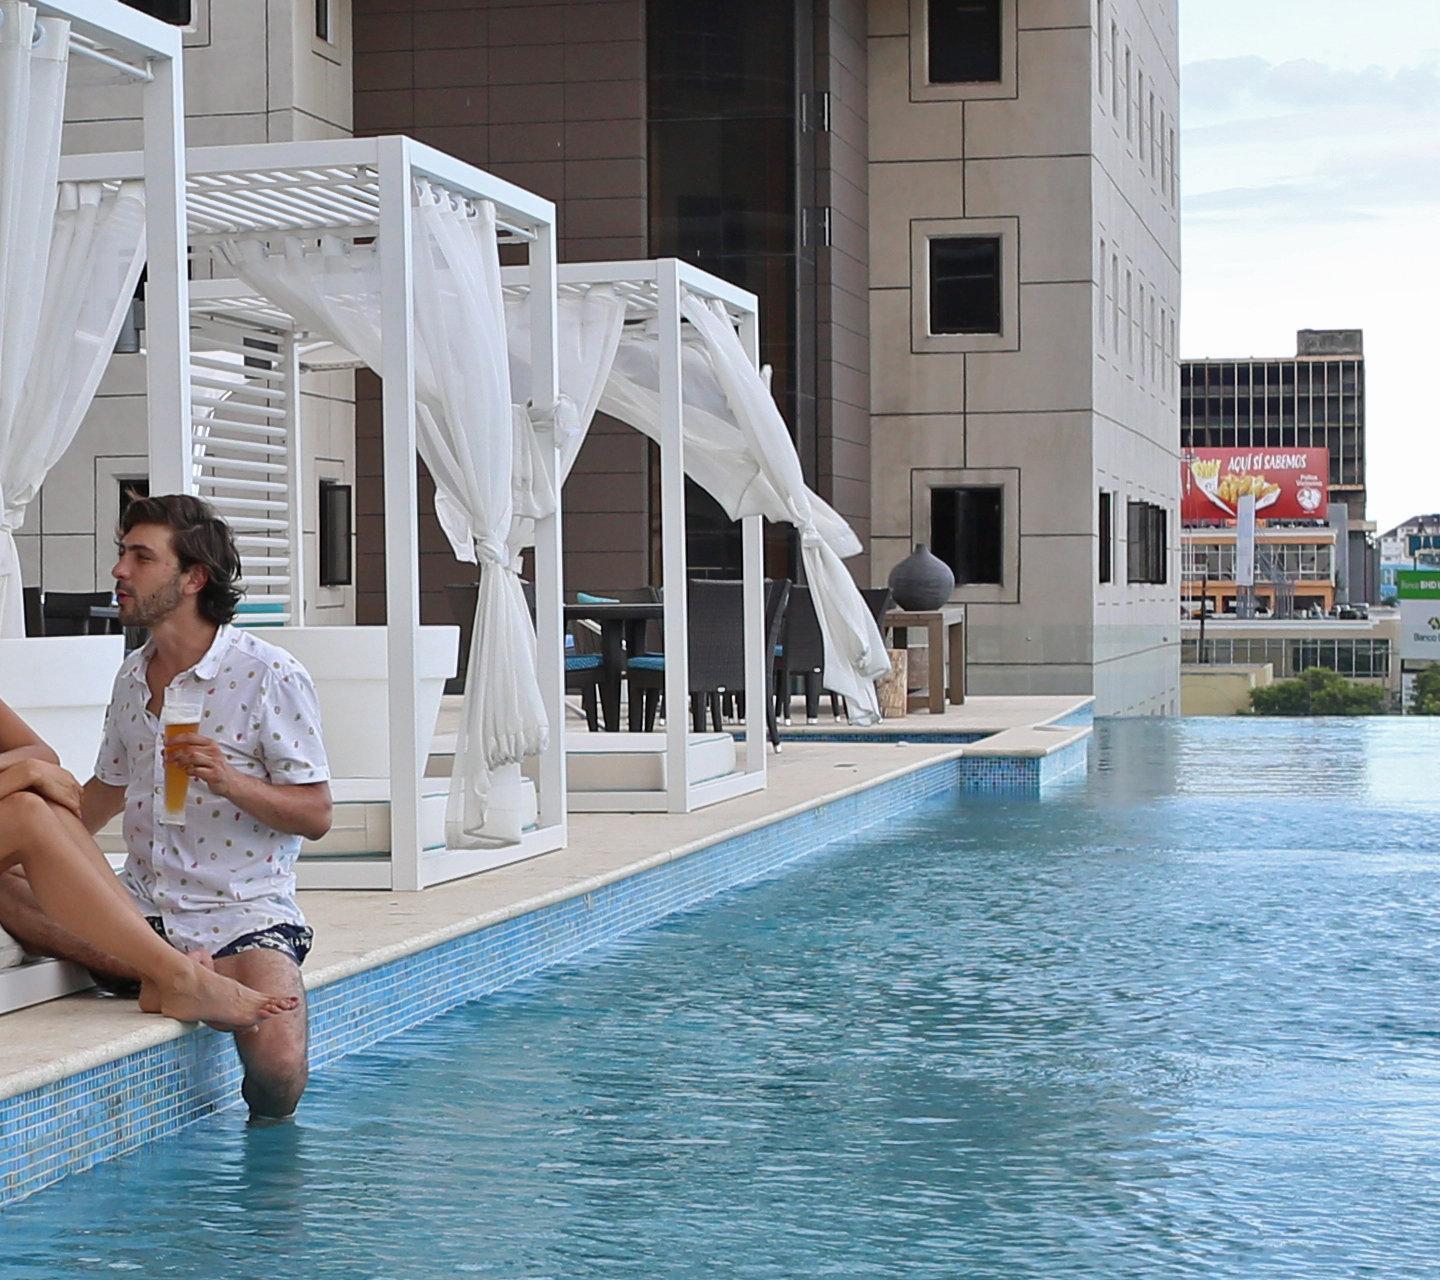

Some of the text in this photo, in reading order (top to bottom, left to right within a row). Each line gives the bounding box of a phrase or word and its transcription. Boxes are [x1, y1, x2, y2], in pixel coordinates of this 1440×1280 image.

[1264, 454, 1307, 470] SABEMOS
[1420, 580, 1437, 589] BHD
[1414, 632, 1437, 641] Banco
